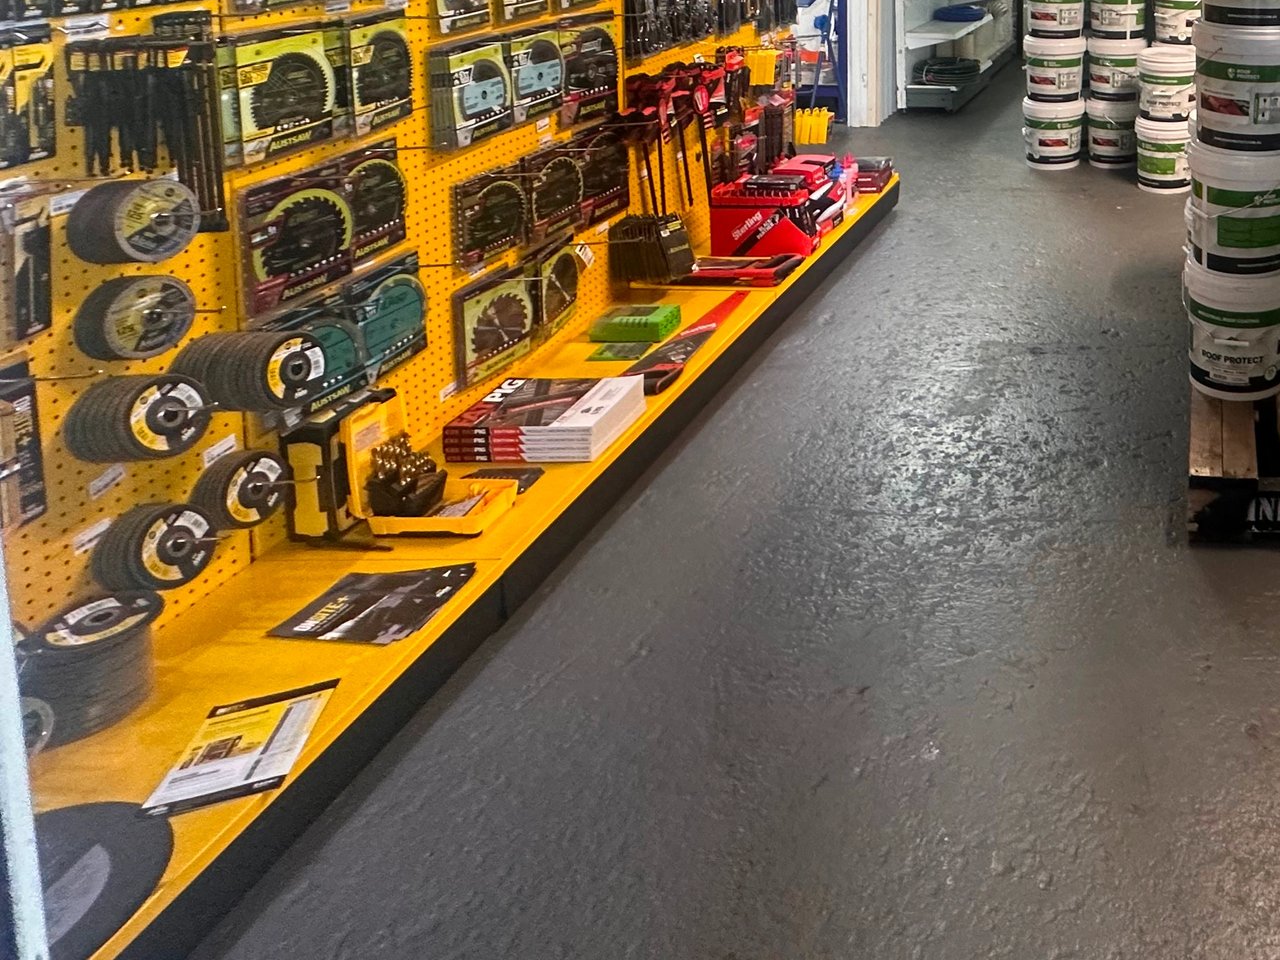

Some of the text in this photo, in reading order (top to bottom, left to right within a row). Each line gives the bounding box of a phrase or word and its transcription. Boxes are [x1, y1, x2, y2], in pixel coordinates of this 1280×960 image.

[270, 130, 312, 152] AUSTSAW
[731, 211, 763, 241] Sterling
[355, 236, 390, 259] AUSTSAW
[282, 273, 328, 300] AUSTSAW
[1202, 349, 1264, 364] ROOF PROTECT
[311, 384, 351, 412] AUSTSAW
[482, 379, 528, 403] PIG
